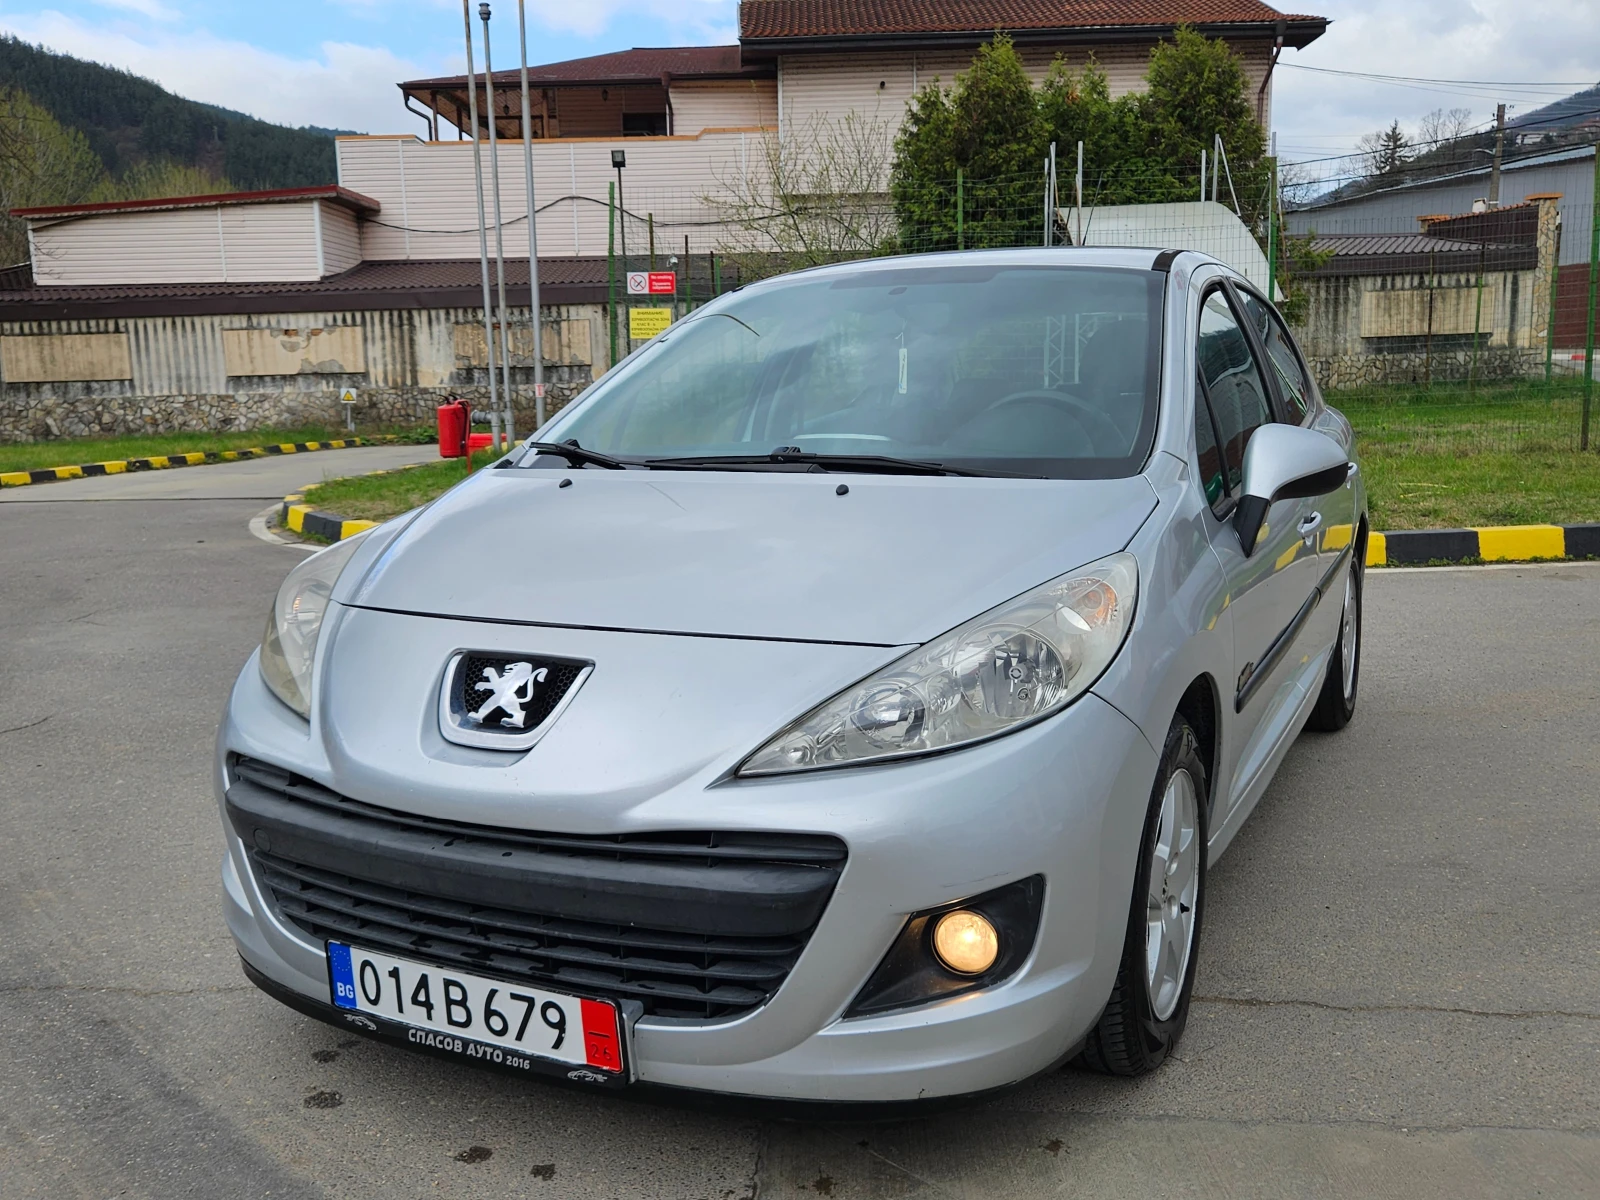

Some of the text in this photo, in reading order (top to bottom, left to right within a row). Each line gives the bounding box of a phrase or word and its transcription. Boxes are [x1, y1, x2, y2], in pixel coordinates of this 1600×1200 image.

[336, 982, 354, 999] BG
[408, 1029, 531, 1070] СПАСОВ АУТО 2016
[590, 1043, 612, 1061] 26
